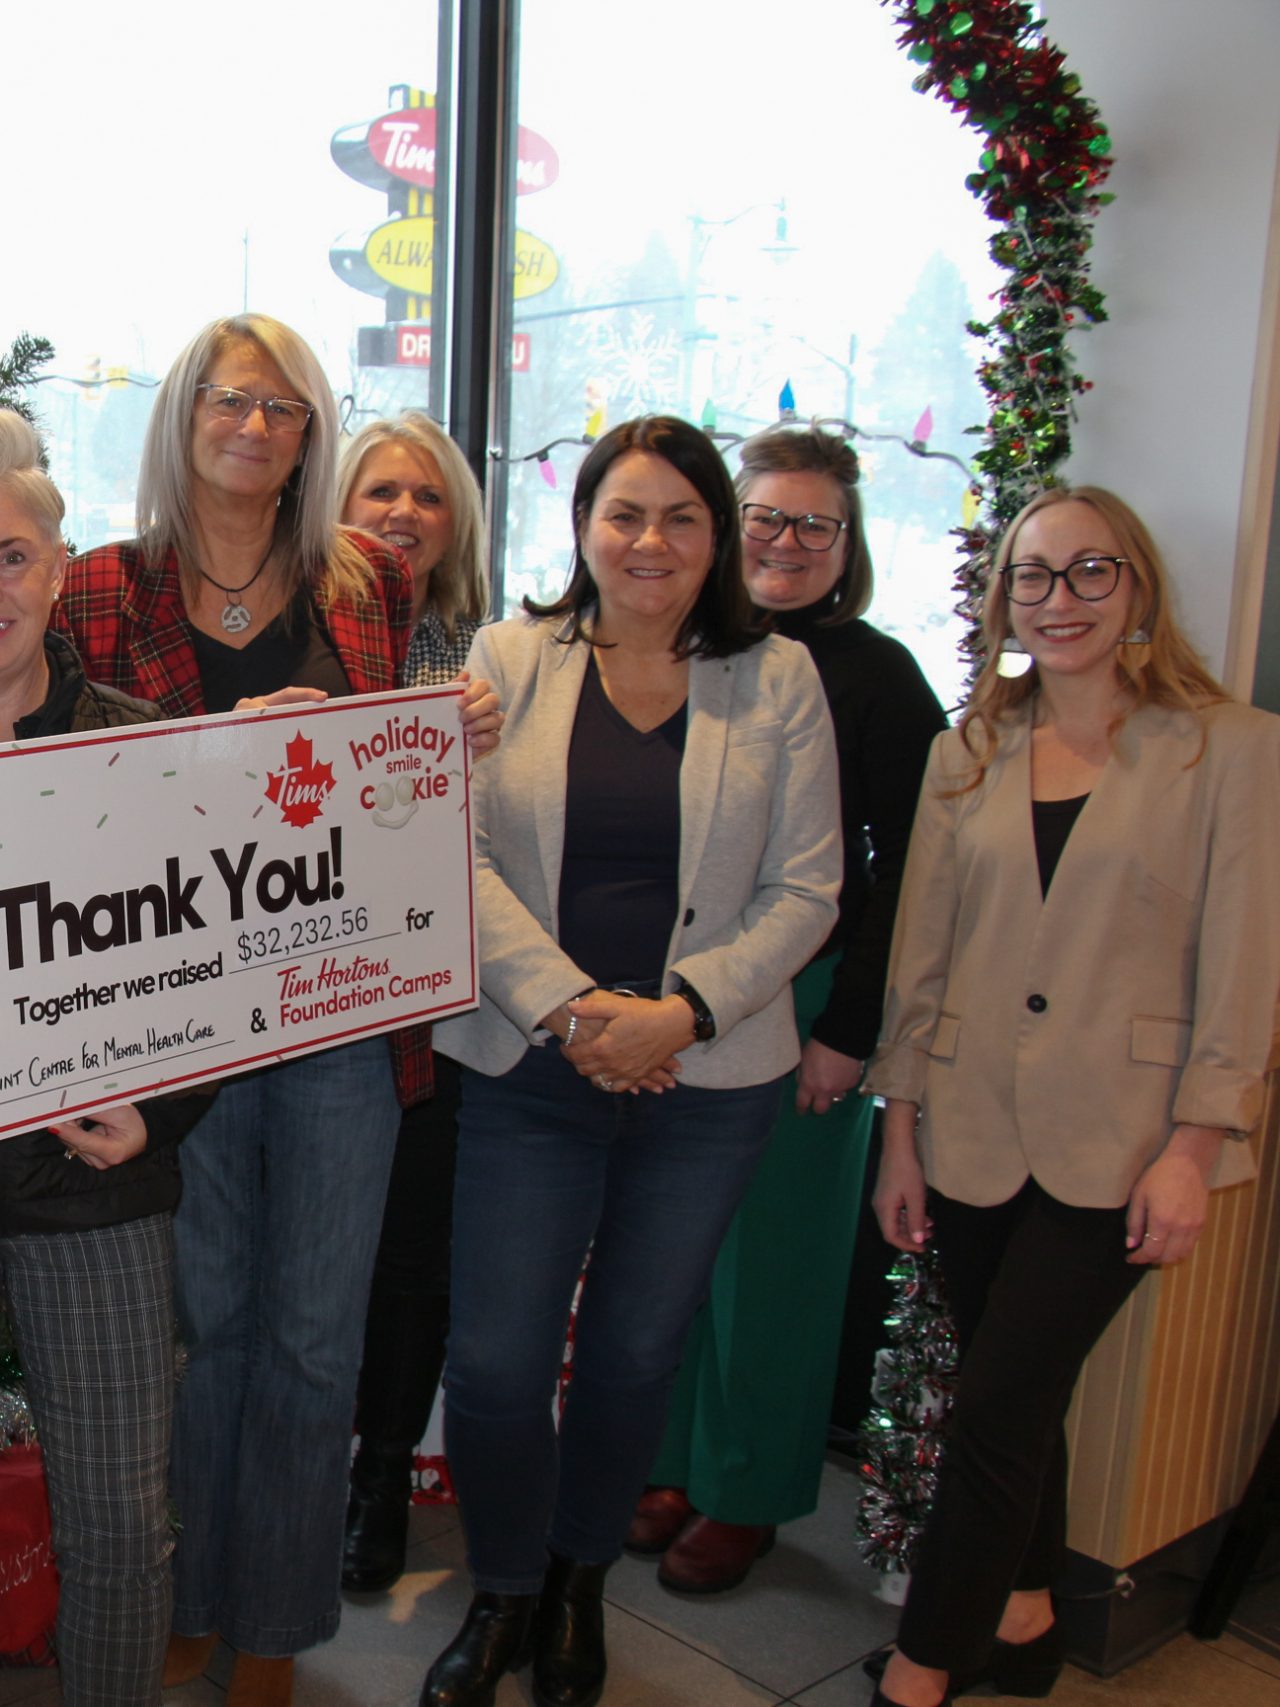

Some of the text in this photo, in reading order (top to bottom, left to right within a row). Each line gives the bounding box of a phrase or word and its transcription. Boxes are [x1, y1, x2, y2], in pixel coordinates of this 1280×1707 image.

[349, 716, 456, 771] holiday
[386, 754, 422, 774] smile
[272, 766, 329, 808] Tims
[209, 826, 345, 922] You!
[13, 906, 434, 1027] Together we raised $32,232.56 for
[277, 955, 390, 1001] Tim Hortons
[250, 1007, 268, 1034] &
[280, 969, 452, 1028] Foundation Camps
[28, 1057, 76, 1087] CENTRE
[81, 1042, 100, 1071] FOR
[103, 1037, 145, 1067] MENTAL
[146, 1027, 184, 1056] HEALTH
[185, 1018, 216, 1044] CARE
